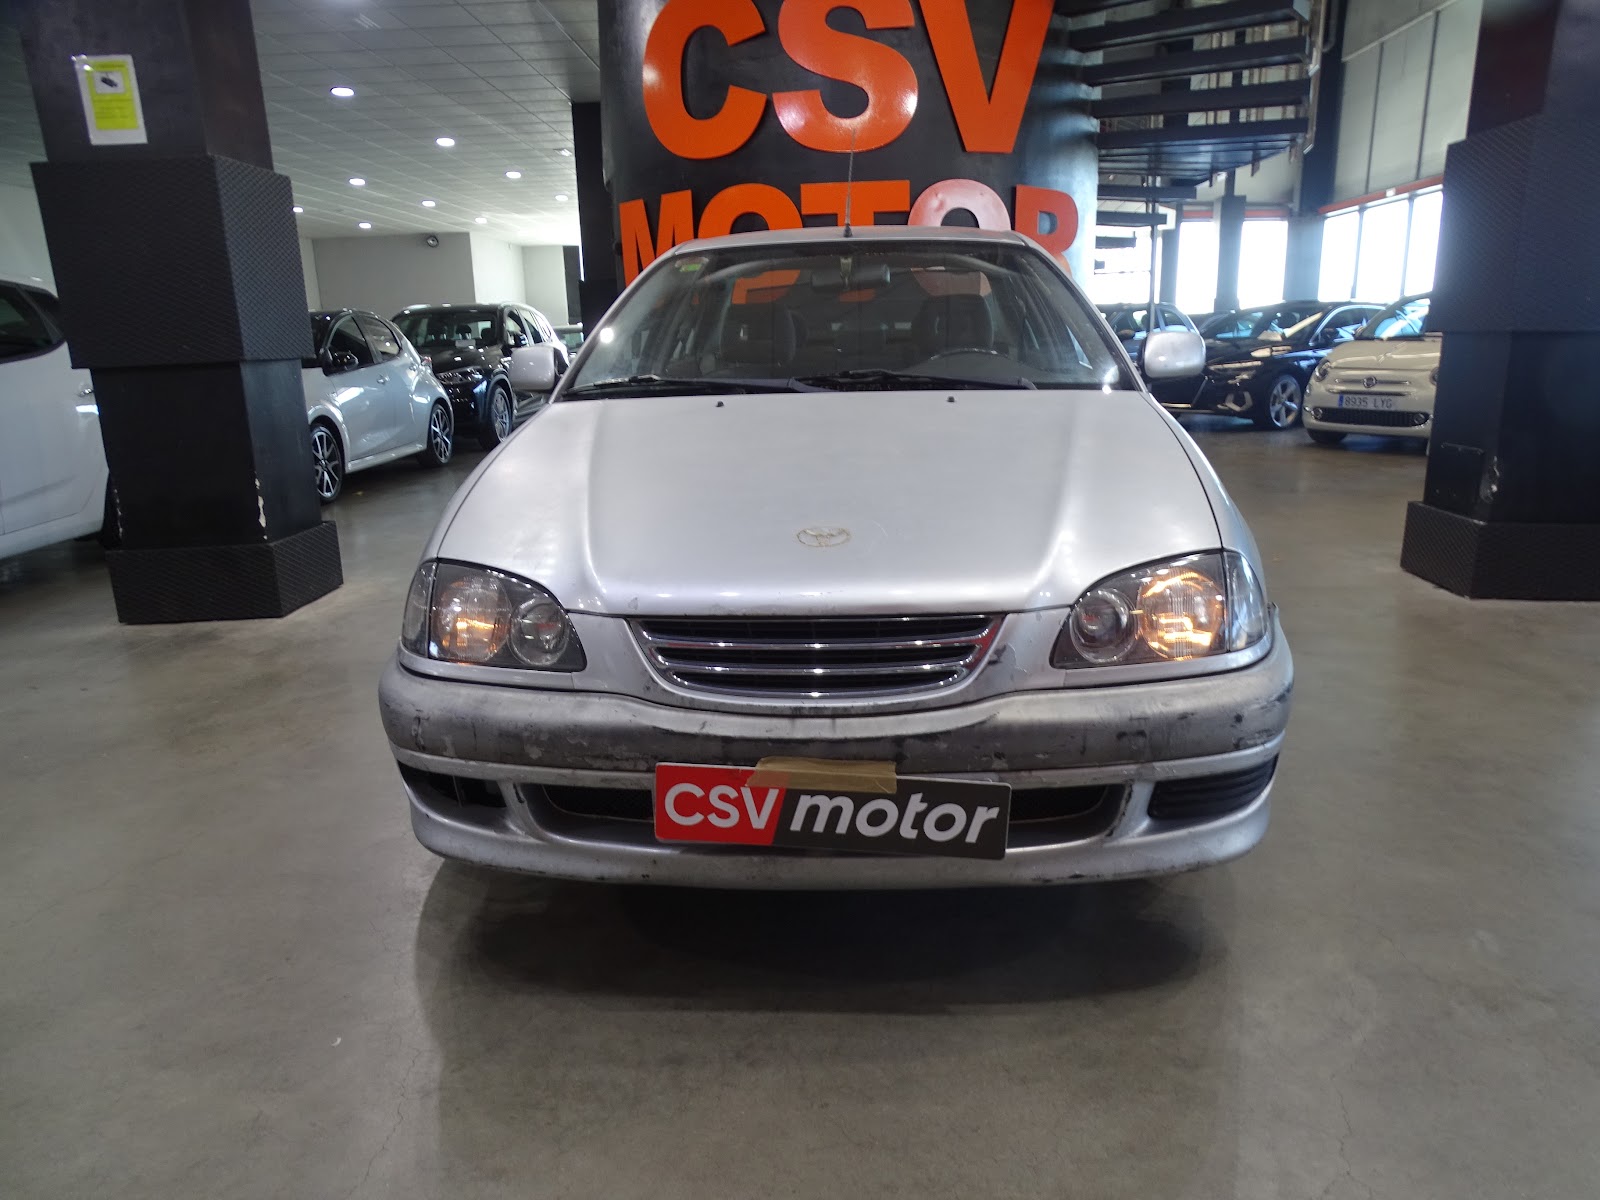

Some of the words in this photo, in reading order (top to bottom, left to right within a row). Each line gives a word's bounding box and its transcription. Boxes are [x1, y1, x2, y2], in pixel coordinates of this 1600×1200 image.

[643, 0, 1054, 159] CSV
[619, 179, 1079, 296] MOTOR
[1344, 396, 1368, 408] 8935
[664, 782, 779, 829] CSV
[790, 792, 1000, 843] motor
